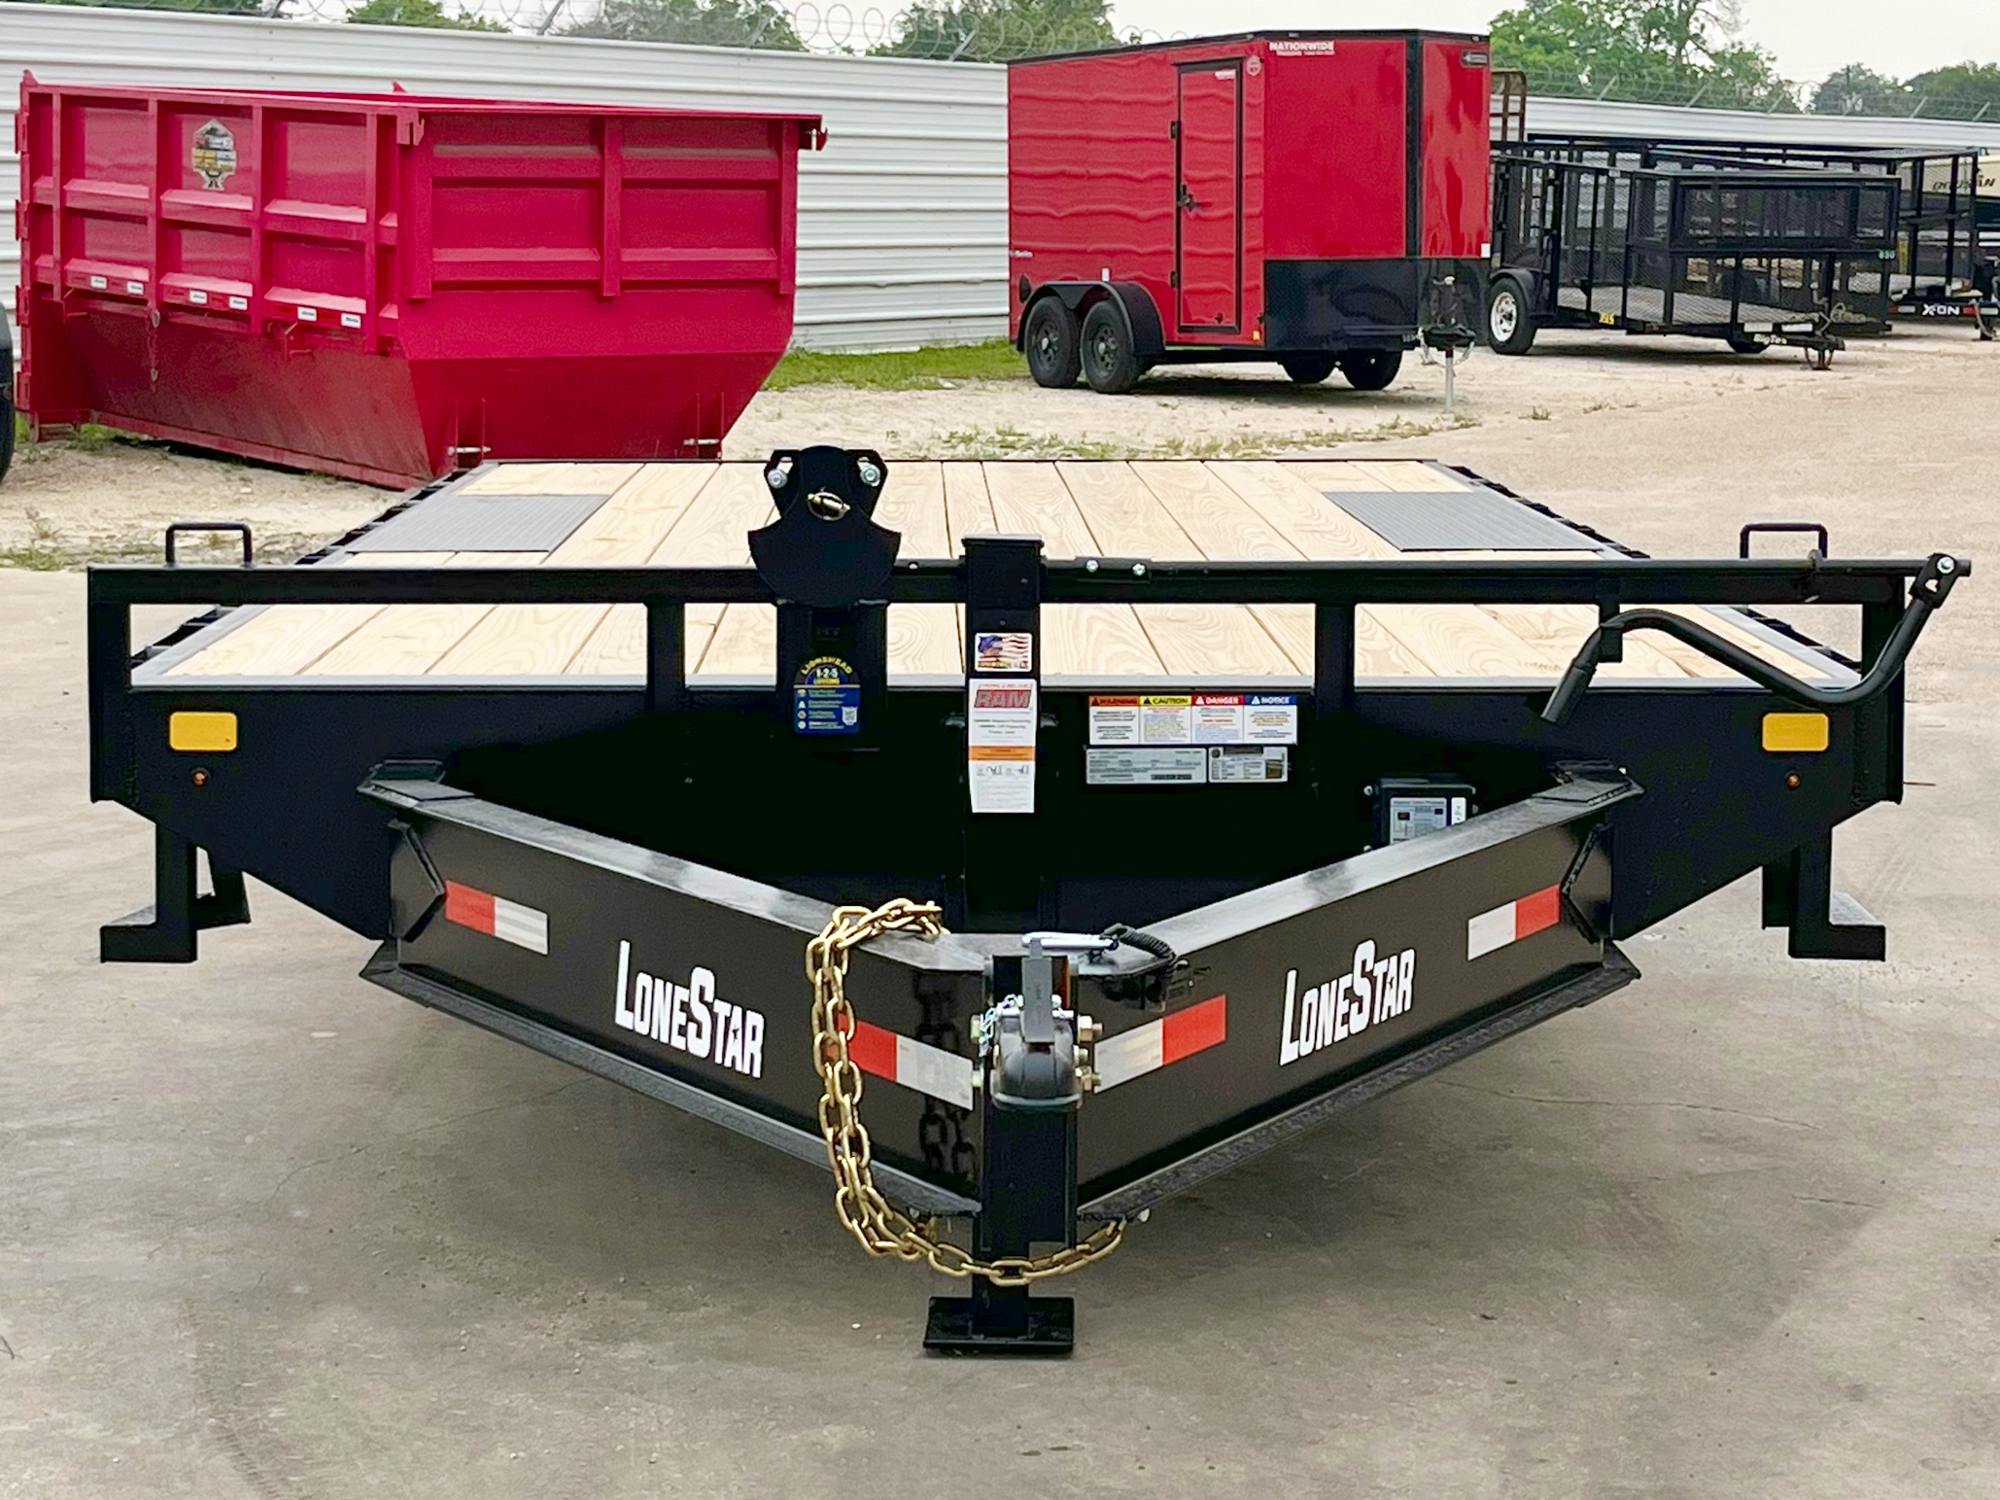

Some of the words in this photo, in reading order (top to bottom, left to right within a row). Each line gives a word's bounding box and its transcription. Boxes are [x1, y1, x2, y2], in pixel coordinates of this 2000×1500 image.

[1269, 41, 1335, 51] NATIONWIDE
[976, 690, 1031, 708] RAM
[1099, 697, 1138, 705] WARNING
[1152, 697, 1189, 705] CAUTION
[1205, 696, 1239, 705] DANGER
[1260, 696, 1290, 705] NOTICE
